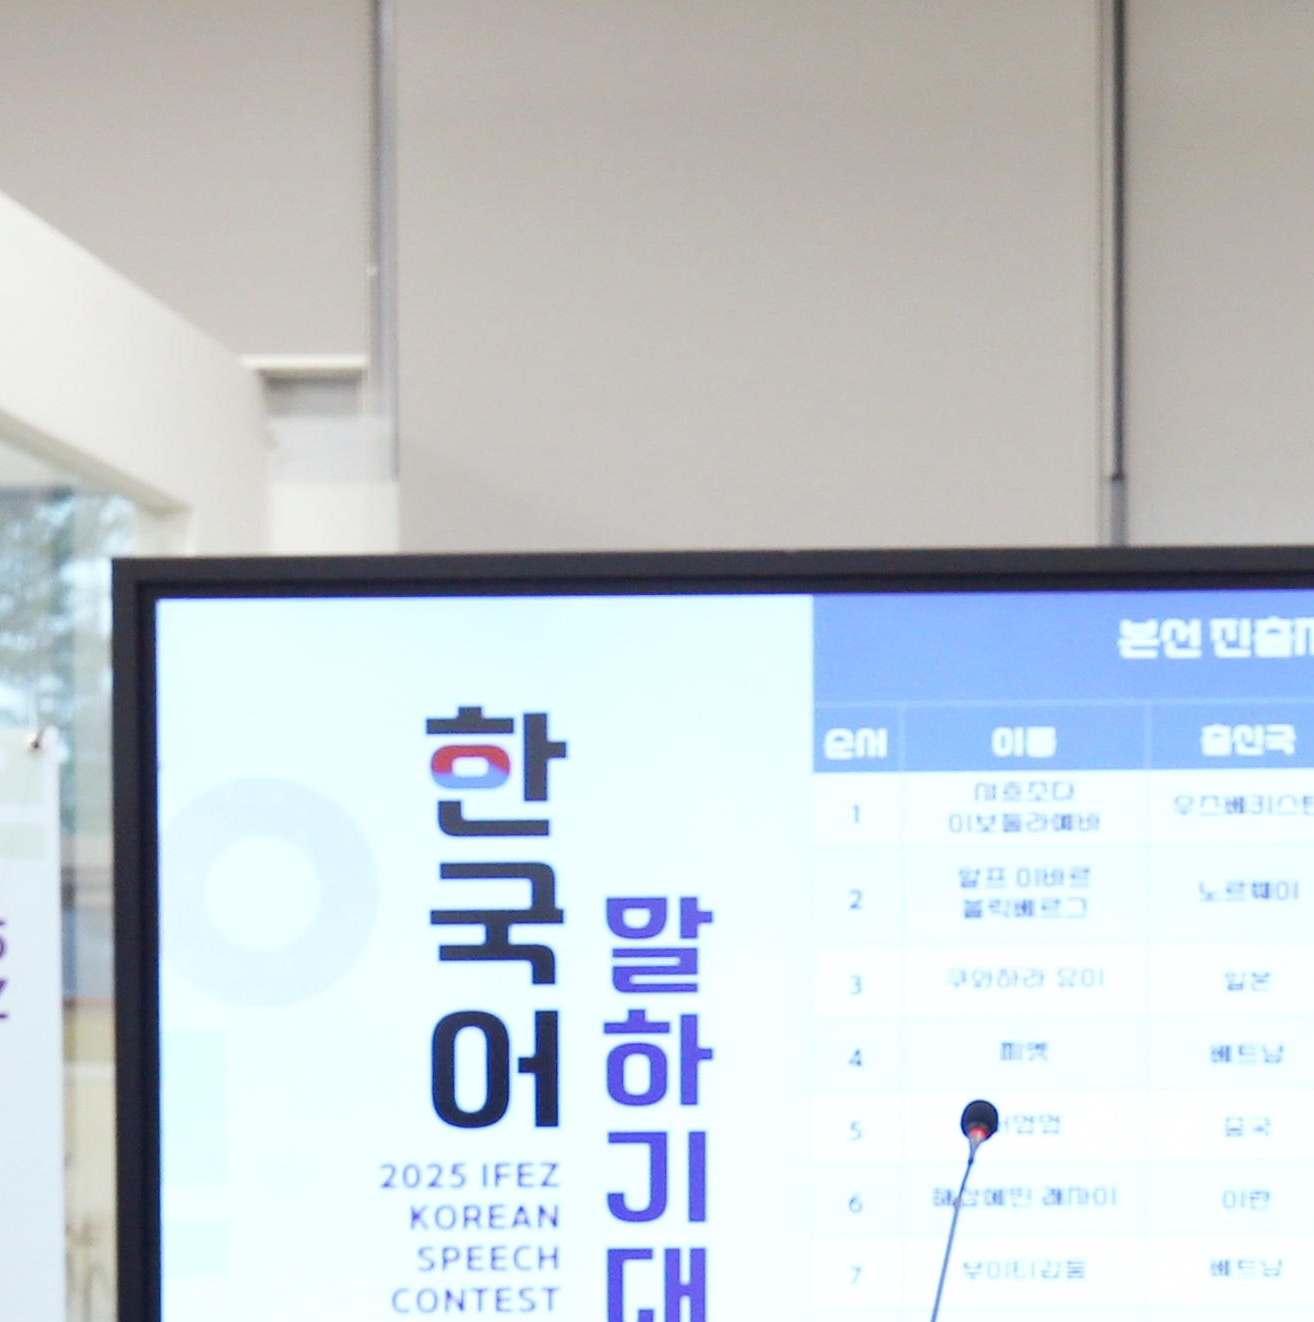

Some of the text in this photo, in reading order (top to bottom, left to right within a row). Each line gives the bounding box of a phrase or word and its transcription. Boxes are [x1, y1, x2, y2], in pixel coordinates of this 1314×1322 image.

[853, 804, 860, 823] 1
[849, 889, 862, 910] 2
[1200, 881, 1298, 901] 노르웨이
[426, 706, 567, 1129] 한국어
[851, 975, 863, 995] 3
[849, 1049, 862, 1067] 4
[1211, 1045, 1283, 1063] 베트남
[850, 1121, 862, 1141] 5
[380, 1162, 558, 1189] 2025 IFEZ
[848, 1195, 863, 1213] 6
[411, 1205, 558, 1229] KOREAN
[418, 1246, 559, 1271] SPEECH
[851, 1266, 862, 1284] 7
[1210, 1259, 1282, 1277] 베트남
[392, 1287, 558, 1313] CONTEST
